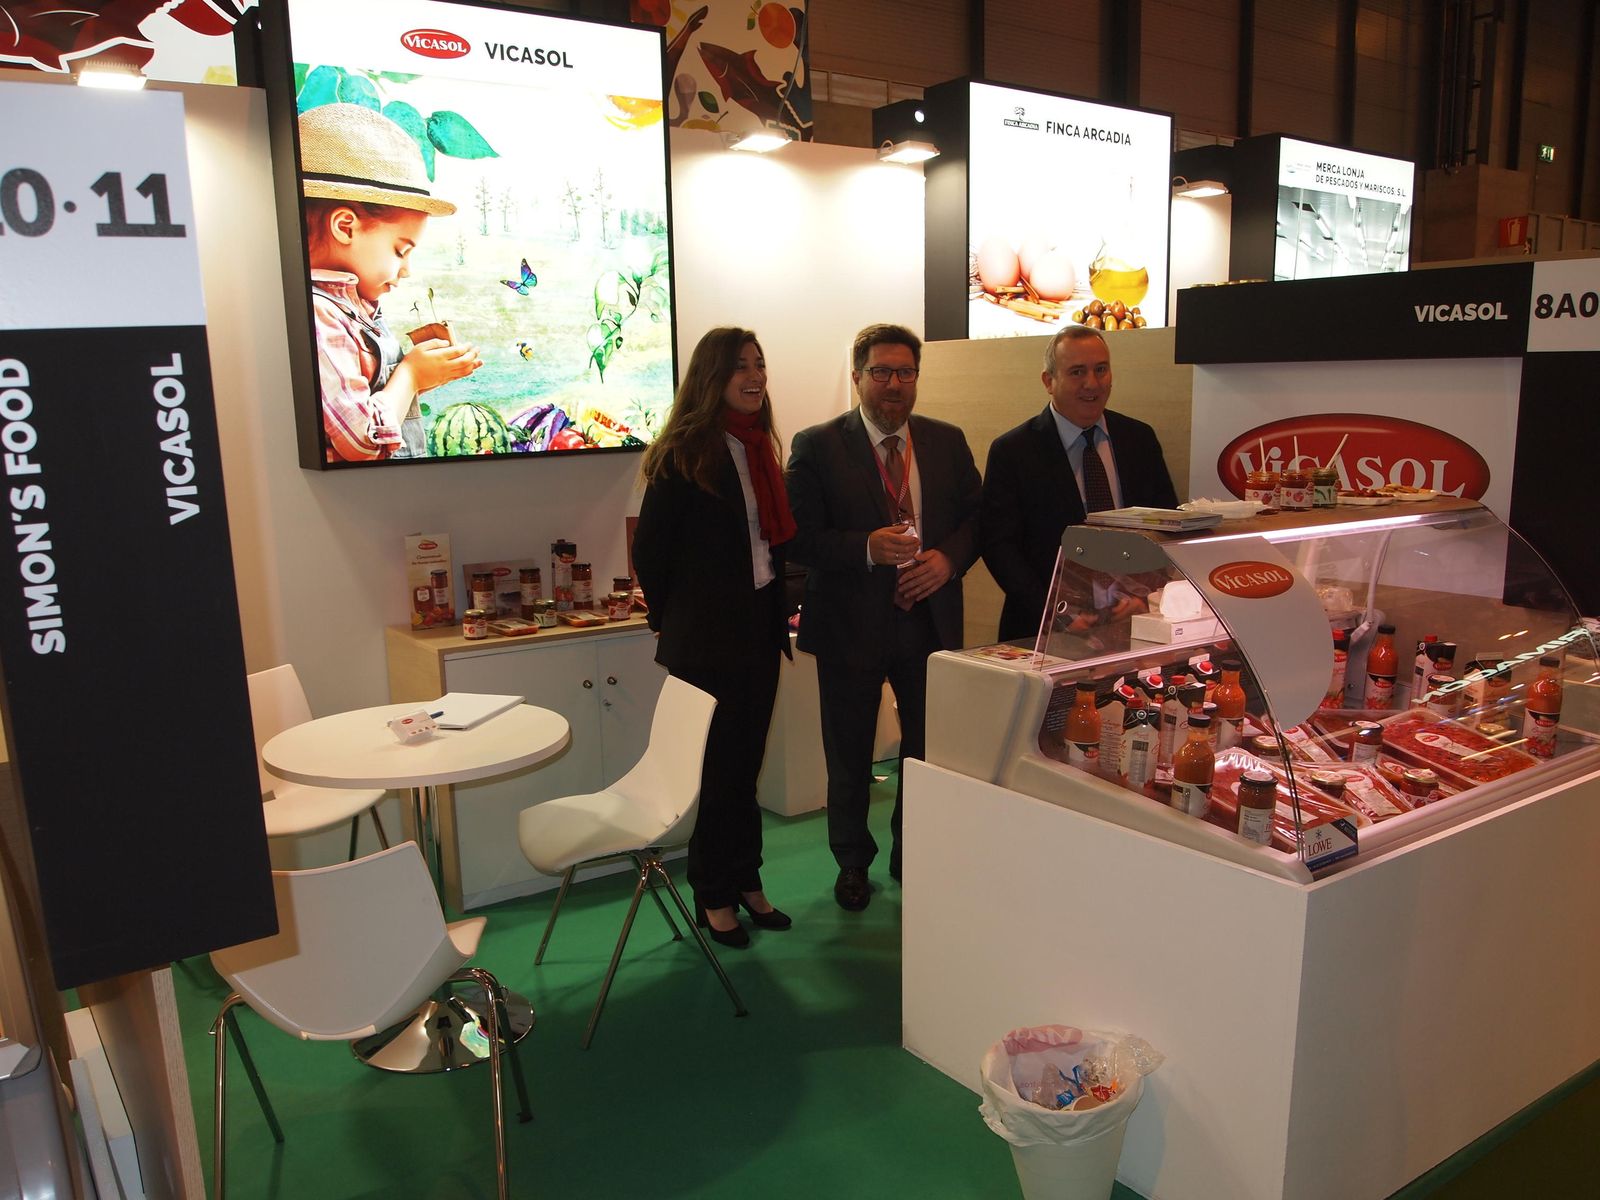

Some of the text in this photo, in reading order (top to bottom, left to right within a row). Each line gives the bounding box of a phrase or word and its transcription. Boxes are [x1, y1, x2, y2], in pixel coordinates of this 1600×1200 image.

[485, 41, 574, 69] VICASOL
[1046, 121, 1132, 146] FINCA ARCADIA
[1315, 161, 1342, 175] MERCA
[1342, 166, 1365, 179] LONJA
[1315, 174, 1324, 184] DE
[1325, 175, 1358, 190] PESCADOS
[1359, 182, 1364, 190] Y
[1414, 302, 1509, 323] VICASOL
[150, 352, 200, 526] VICASOL
[0, 358, 67, 655] SIMON'S FOOD
[1307, 837, 1333, 857] LOWE
